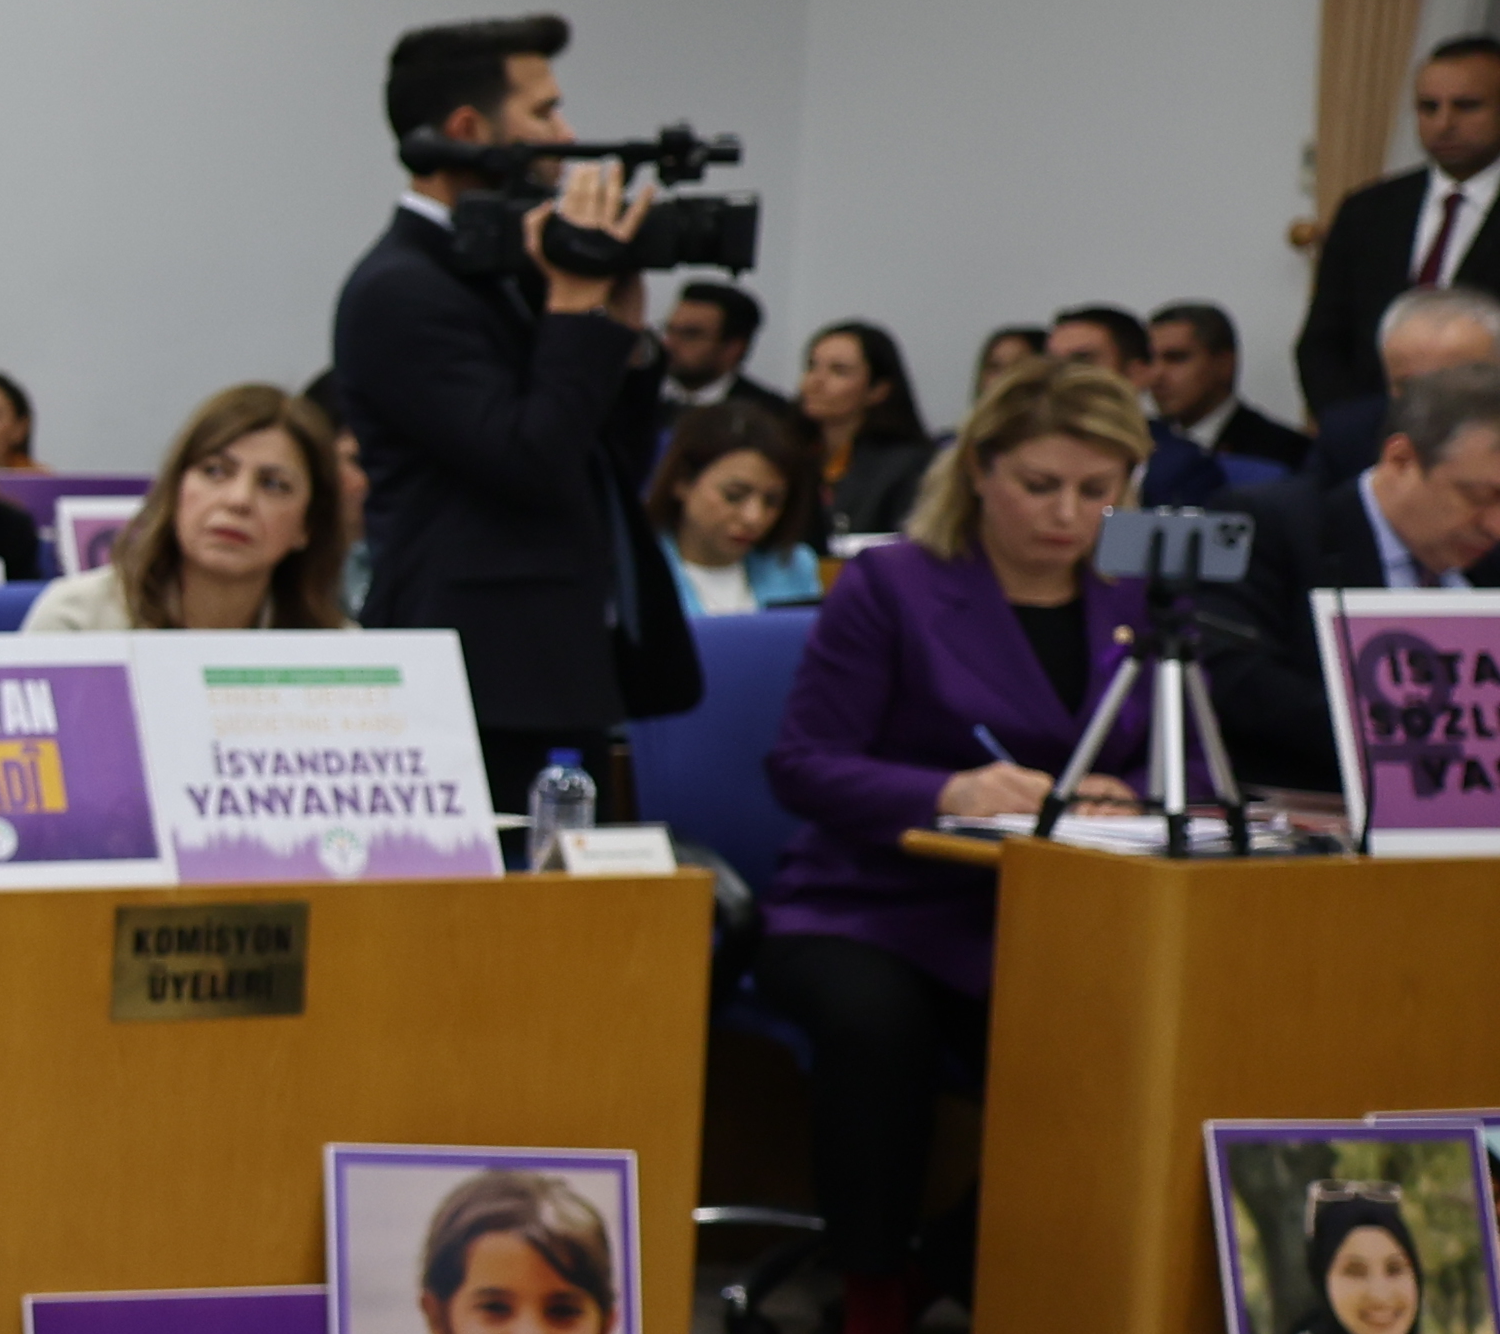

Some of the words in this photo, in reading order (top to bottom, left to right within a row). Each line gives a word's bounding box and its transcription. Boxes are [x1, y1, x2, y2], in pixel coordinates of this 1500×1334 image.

[1368, 693, 1500, 739] SÖZL
[210, 738, 426, 779] İSYANDAYIZ
[1420, 755, 1500, 793] VA
[185, 781, 464, 817] YANYANAYIZ
[133, 916, 292, 955] KOMİSYON
